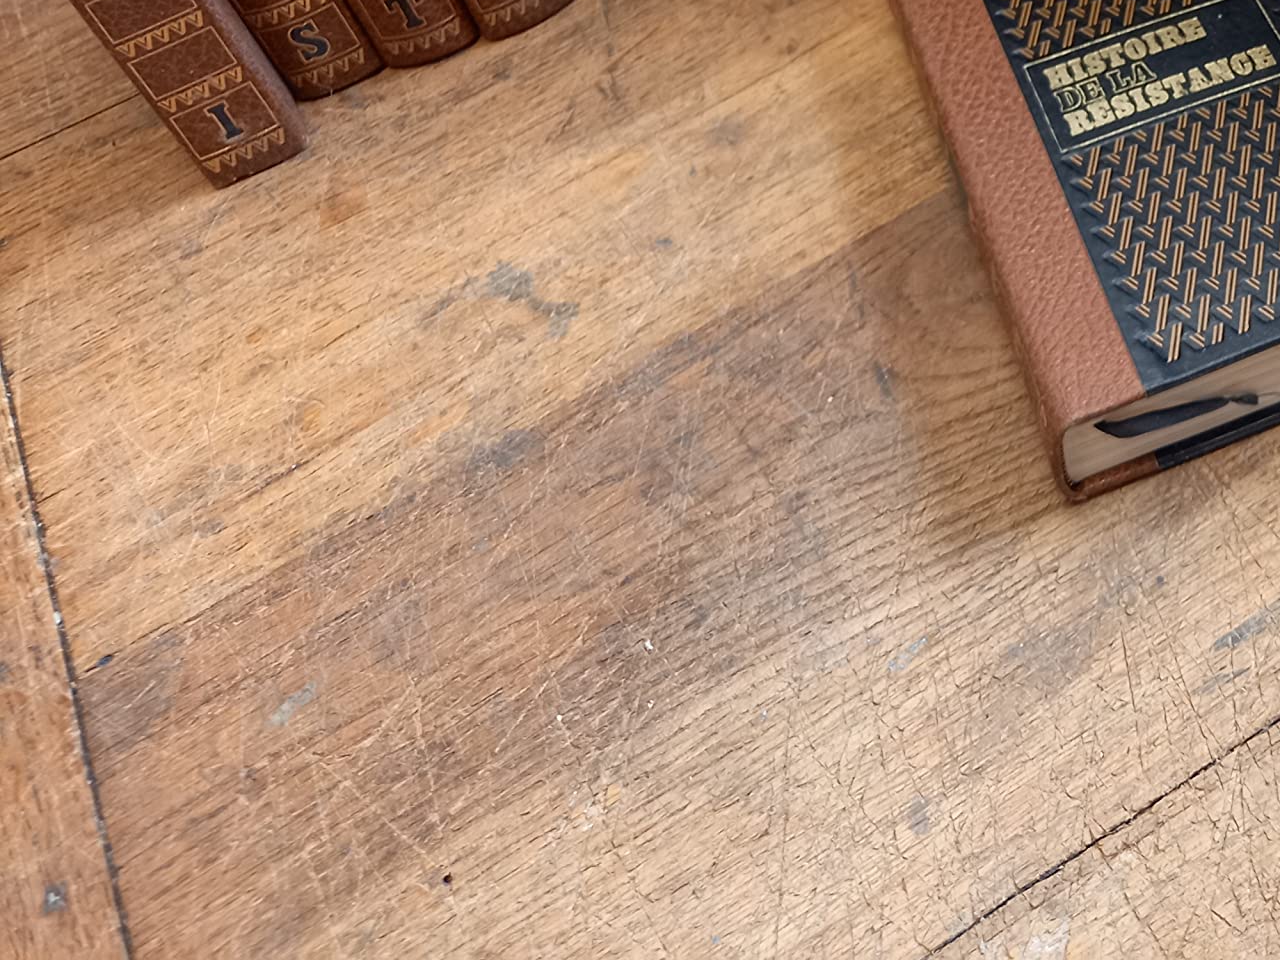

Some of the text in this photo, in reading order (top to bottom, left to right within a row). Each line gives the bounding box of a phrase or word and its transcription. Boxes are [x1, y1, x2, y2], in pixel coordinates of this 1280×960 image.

[288, 22, 331, 65] S
[1043, 16, 1207, 90] HISTOIRE
[1053, 60, 1158, 112] DE LA
[1062, 44, 1278, 137] RESISTANCE
[204, 100, 245, 141] I
